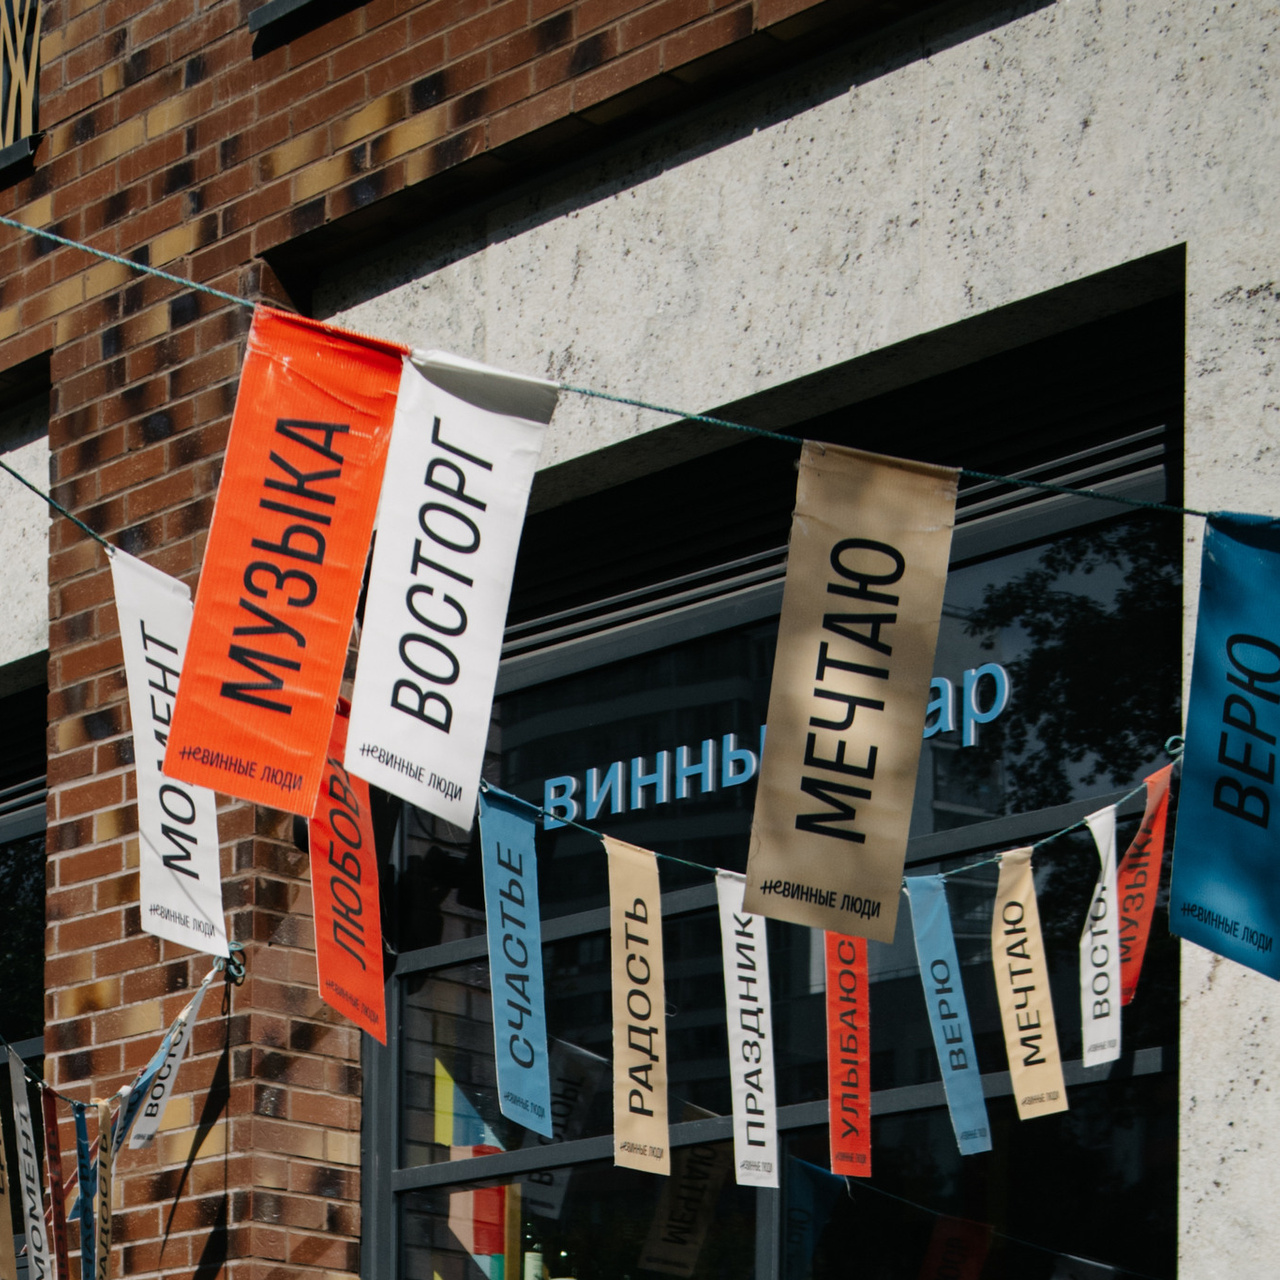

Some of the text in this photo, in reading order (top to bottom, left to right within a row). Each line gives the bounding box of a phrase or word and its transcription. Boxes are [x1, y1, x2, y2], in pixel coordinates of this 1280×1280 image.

[220, 417, 350, 716] МУЗЫКА
[390, 416, 494, 735] ВОСТОРГ
[261, 765, 304, 793] ЛЮДИ
[543, 662, 1011, 831] винны ар
[795, 537, 906, 845] МЕЧТАЮ
[1212, 633, 1280, 830] ВЕРЮ
[427, 771, 463, 801] ЛЮДИ
[192, 918, 216, 939] ЛЮДИ
[497, 841, 536, 1070] СЧАСТЬЕ
[840, 894, 882, 920] ЛЮДИ
[1002, 901, 1047, 1068] МЕЧТАЮ
[1241, 926, 1273, 953] ЛЮДИ
[624, 897, 660, 1118] РАДОСТЬ
[732, 912, 766, 1148] ПРАЗДНИК
[837, 940, 860, 1139] УЛЫБАЮС
[930, 958, 969, 1071] ВЕРЮ
